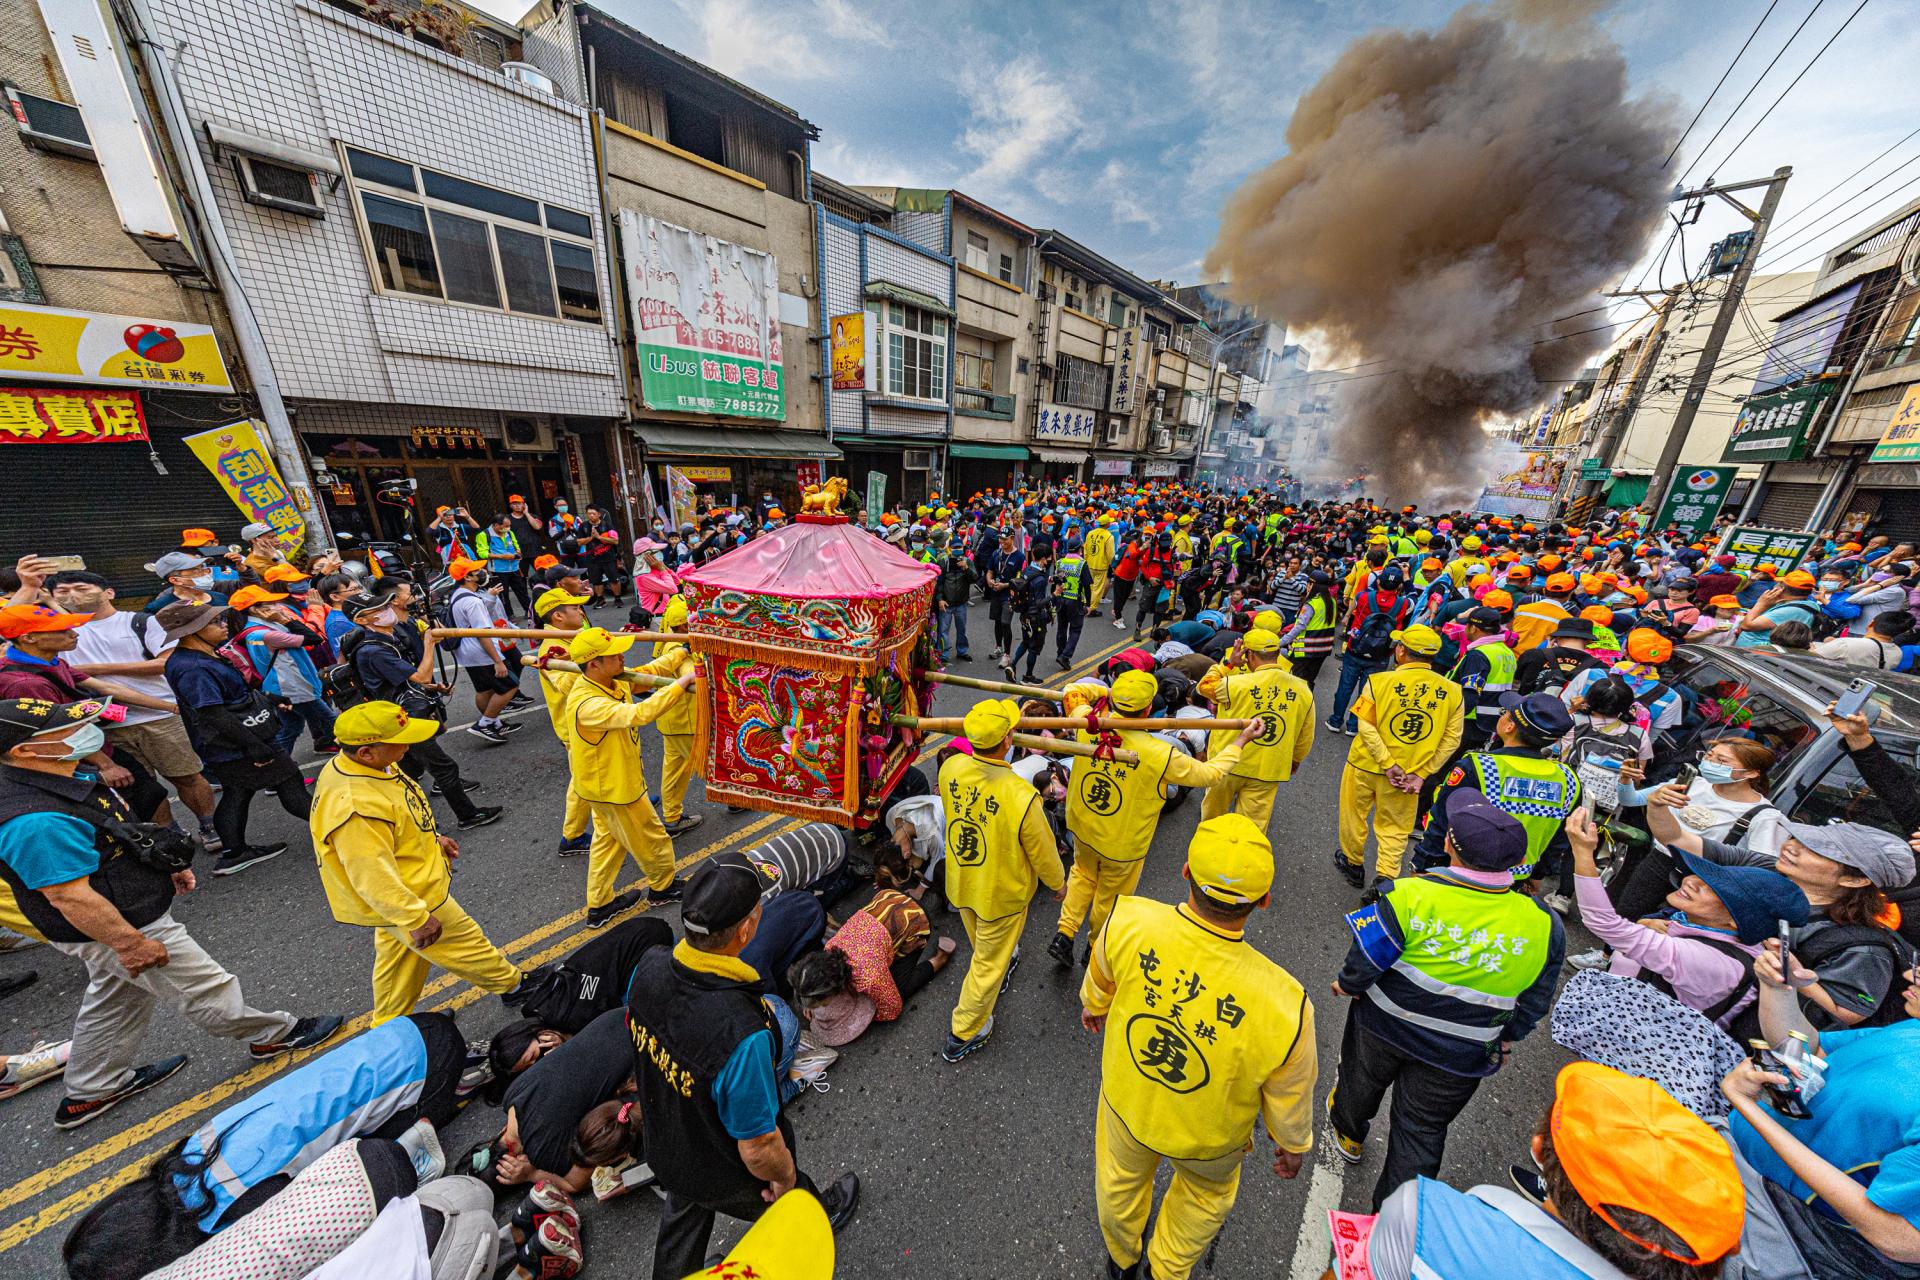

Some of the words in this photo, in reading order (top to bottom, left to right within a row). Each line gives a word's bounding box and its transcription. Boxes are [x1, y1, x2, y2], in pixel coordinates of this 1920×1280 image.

[707, 332, 780, 355] 05-788226
[702, 358, 778, 391] 統聯客運
[0, 393, 143, 438] 專賣店
[723, 397, 780, 415] 7885277
[1730, 531, 1809, 558] 長新
[1398, 712, 1425, 741] 勇
[1086, 776, 1112, 812] 勇
[1509, 787, 1555, 800] POLICE
[955, 823, 980, 862] 勇
[1409, 914, 1529, 956] 白沙屯拱天宮
[1422, 937, 1503, 974] 交通隊
[1139, 1023, 1189, 1084] 勇
